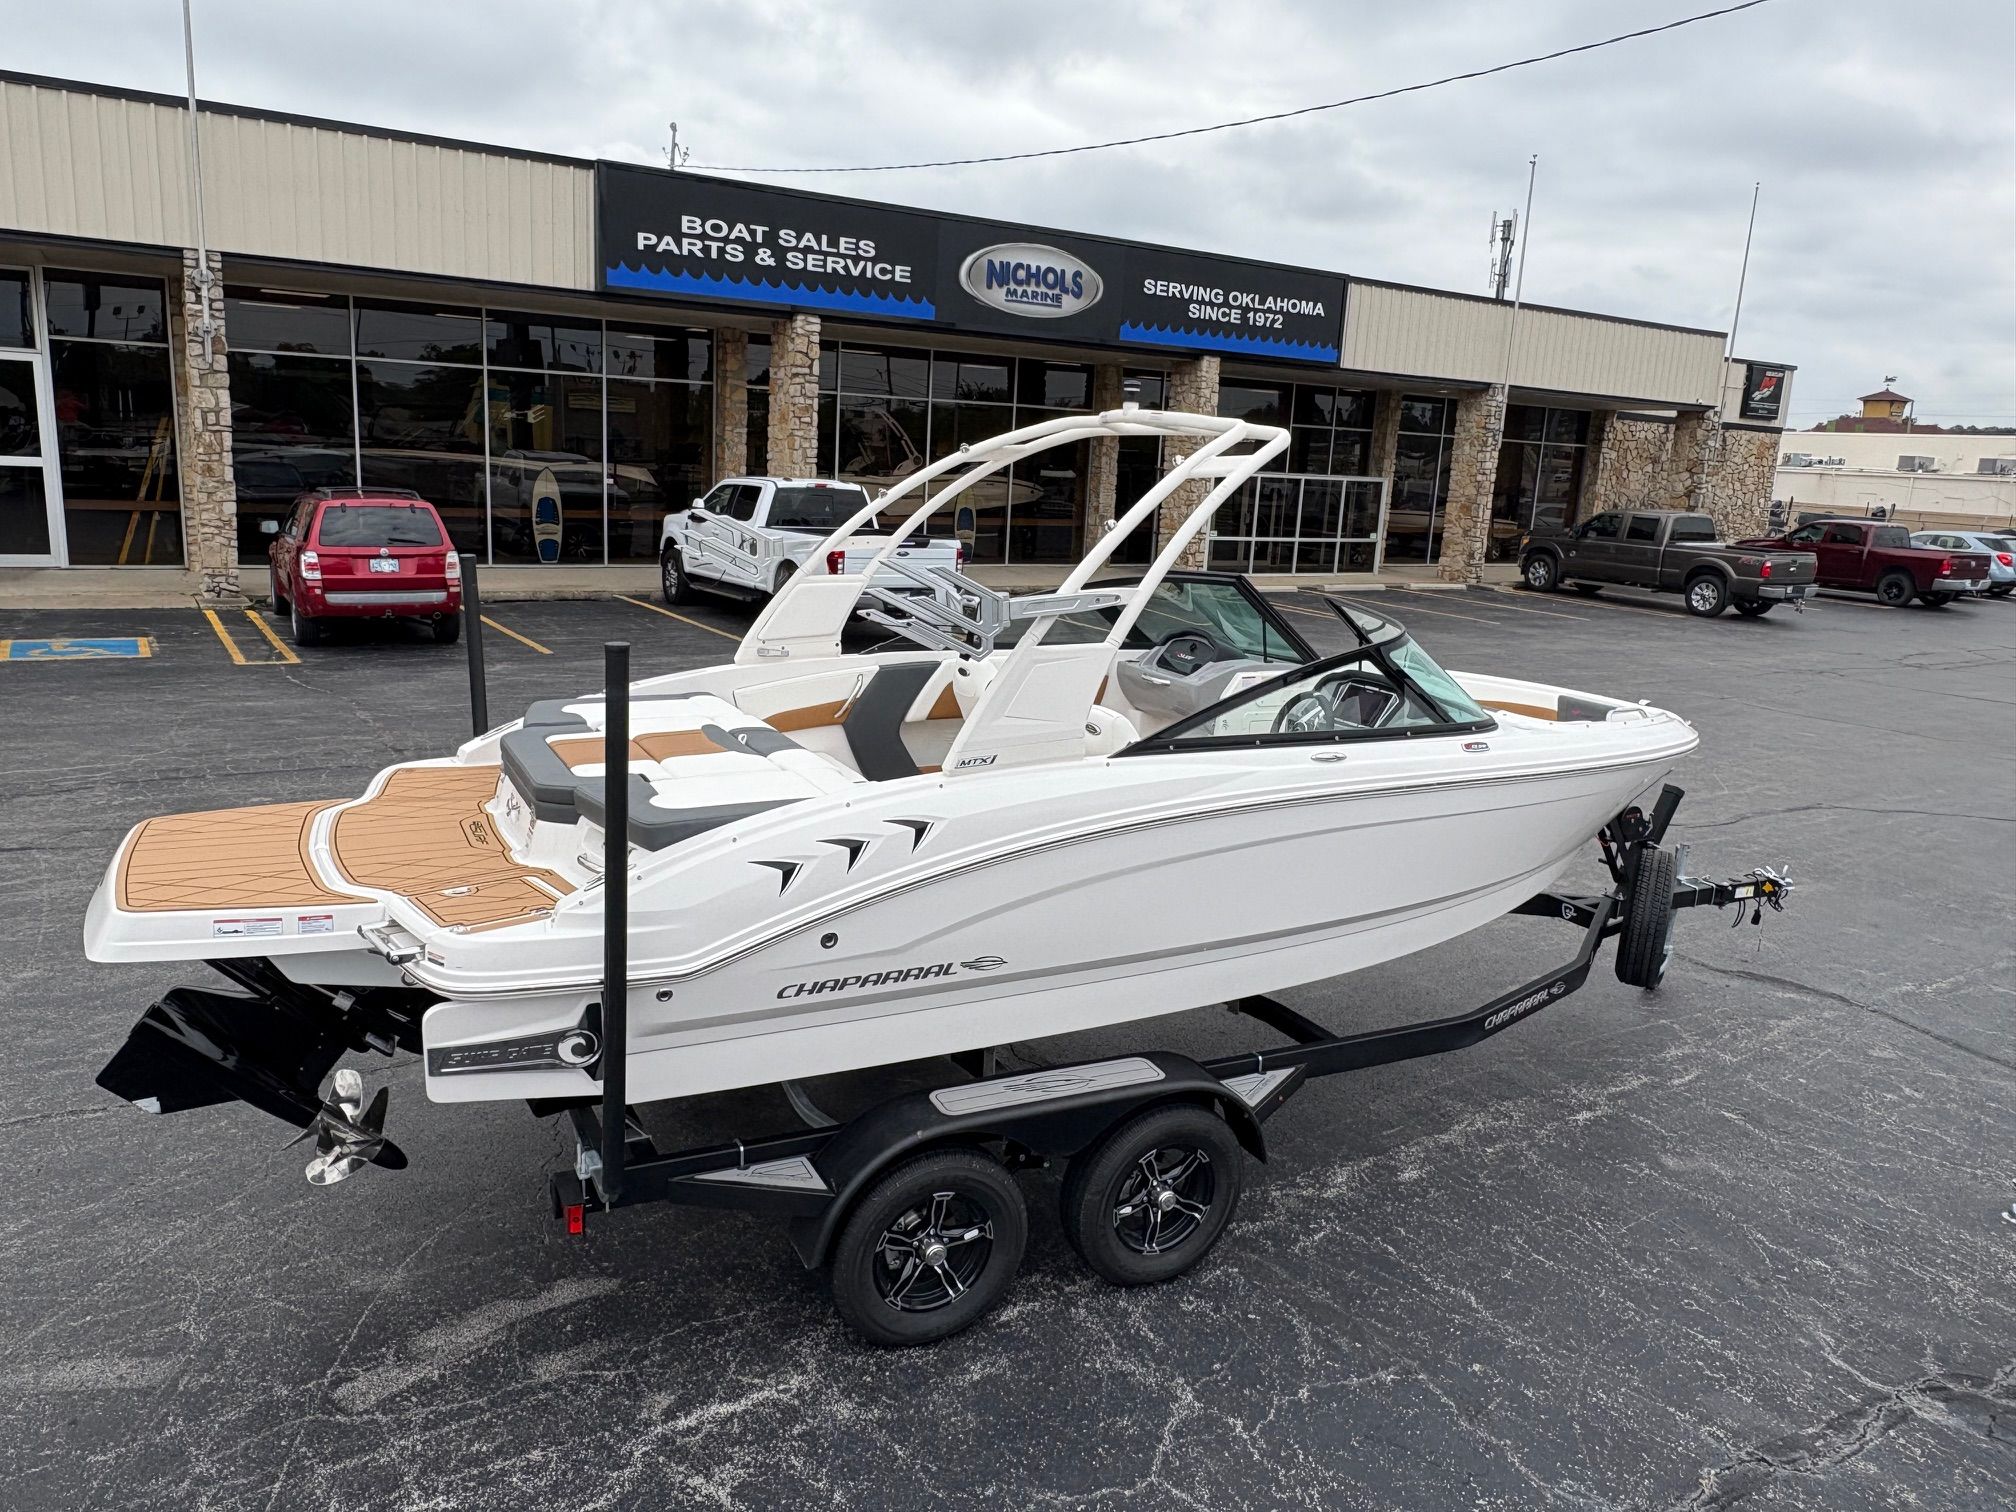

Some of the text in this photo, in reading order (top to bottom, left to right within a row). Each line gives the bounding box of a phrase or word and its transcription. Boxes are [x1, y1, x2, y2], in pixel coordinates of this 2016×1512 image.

[680, 215, 876, 258] BOAT SALES
[637, 232, 912, 284] PARTS & SERVICE
[986, 258, 1084, 299] NICHOLS
[1004, 286, 1063, 304] MARINE
[1143, 279, 1325, 318] SERVING OKLAHOMA
[1188, 303, 1283, 330] SINCE 1972
[959, 756, 991, 767] MTX
[776, 962, 958, 1000] CHAPARRAL
[1484, 988, 1550, 1031] CHAPARRAL
